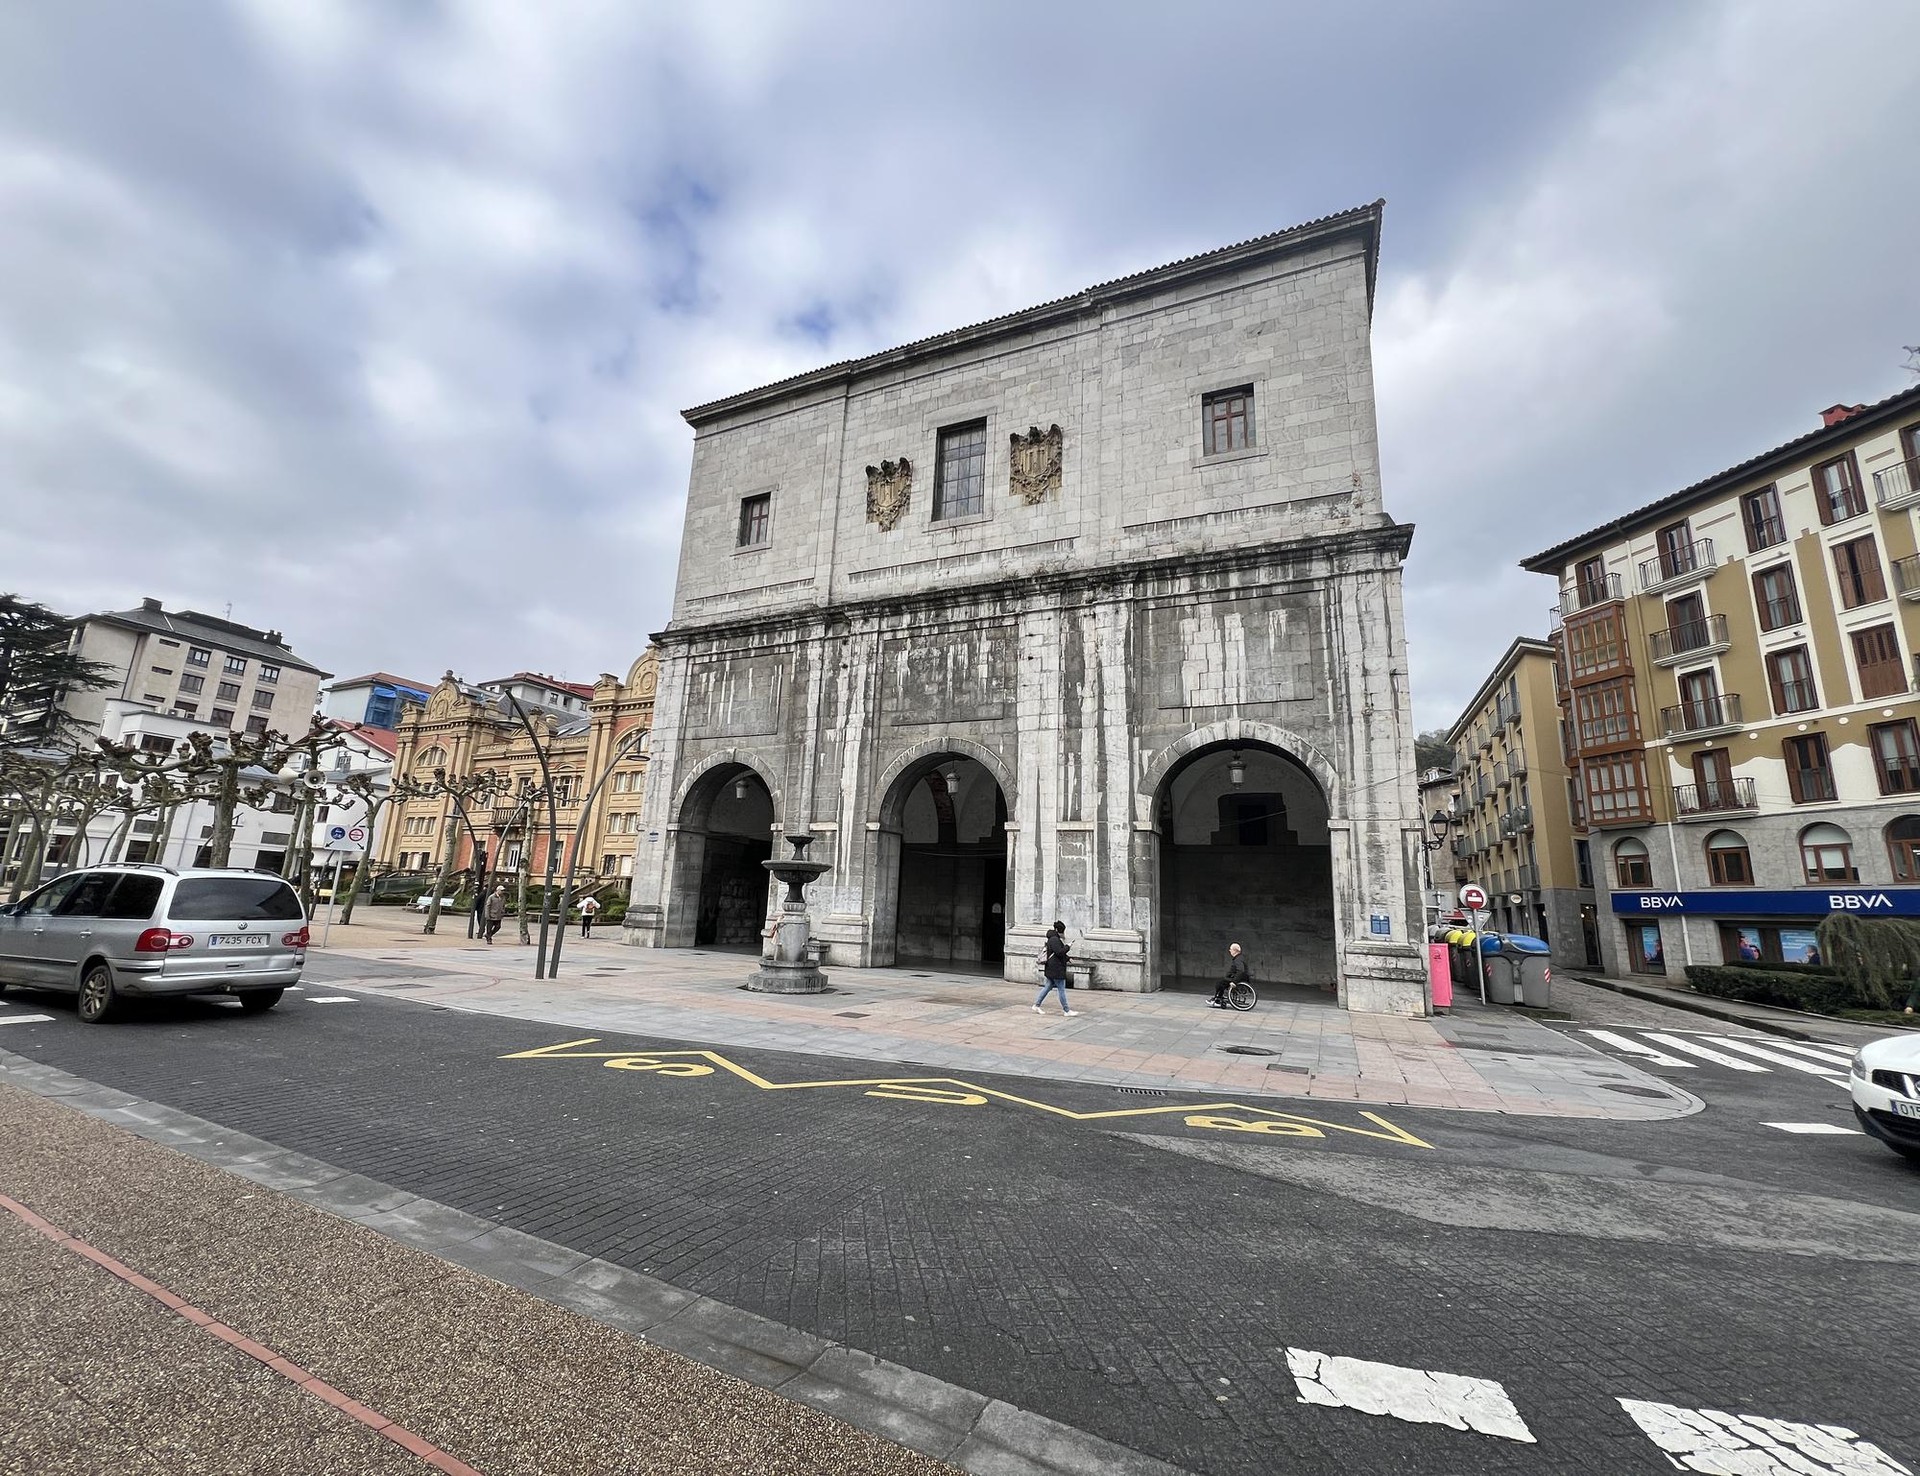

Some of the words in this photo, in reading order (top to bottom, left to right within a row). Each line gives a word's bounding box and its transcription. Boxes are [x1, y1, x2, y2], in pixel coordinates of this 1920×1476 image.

[1640, 895, 1683, 908] BBVA
[1829, 893, 1893, 909] BBVA
[219, 936, 242, 945] 7435
